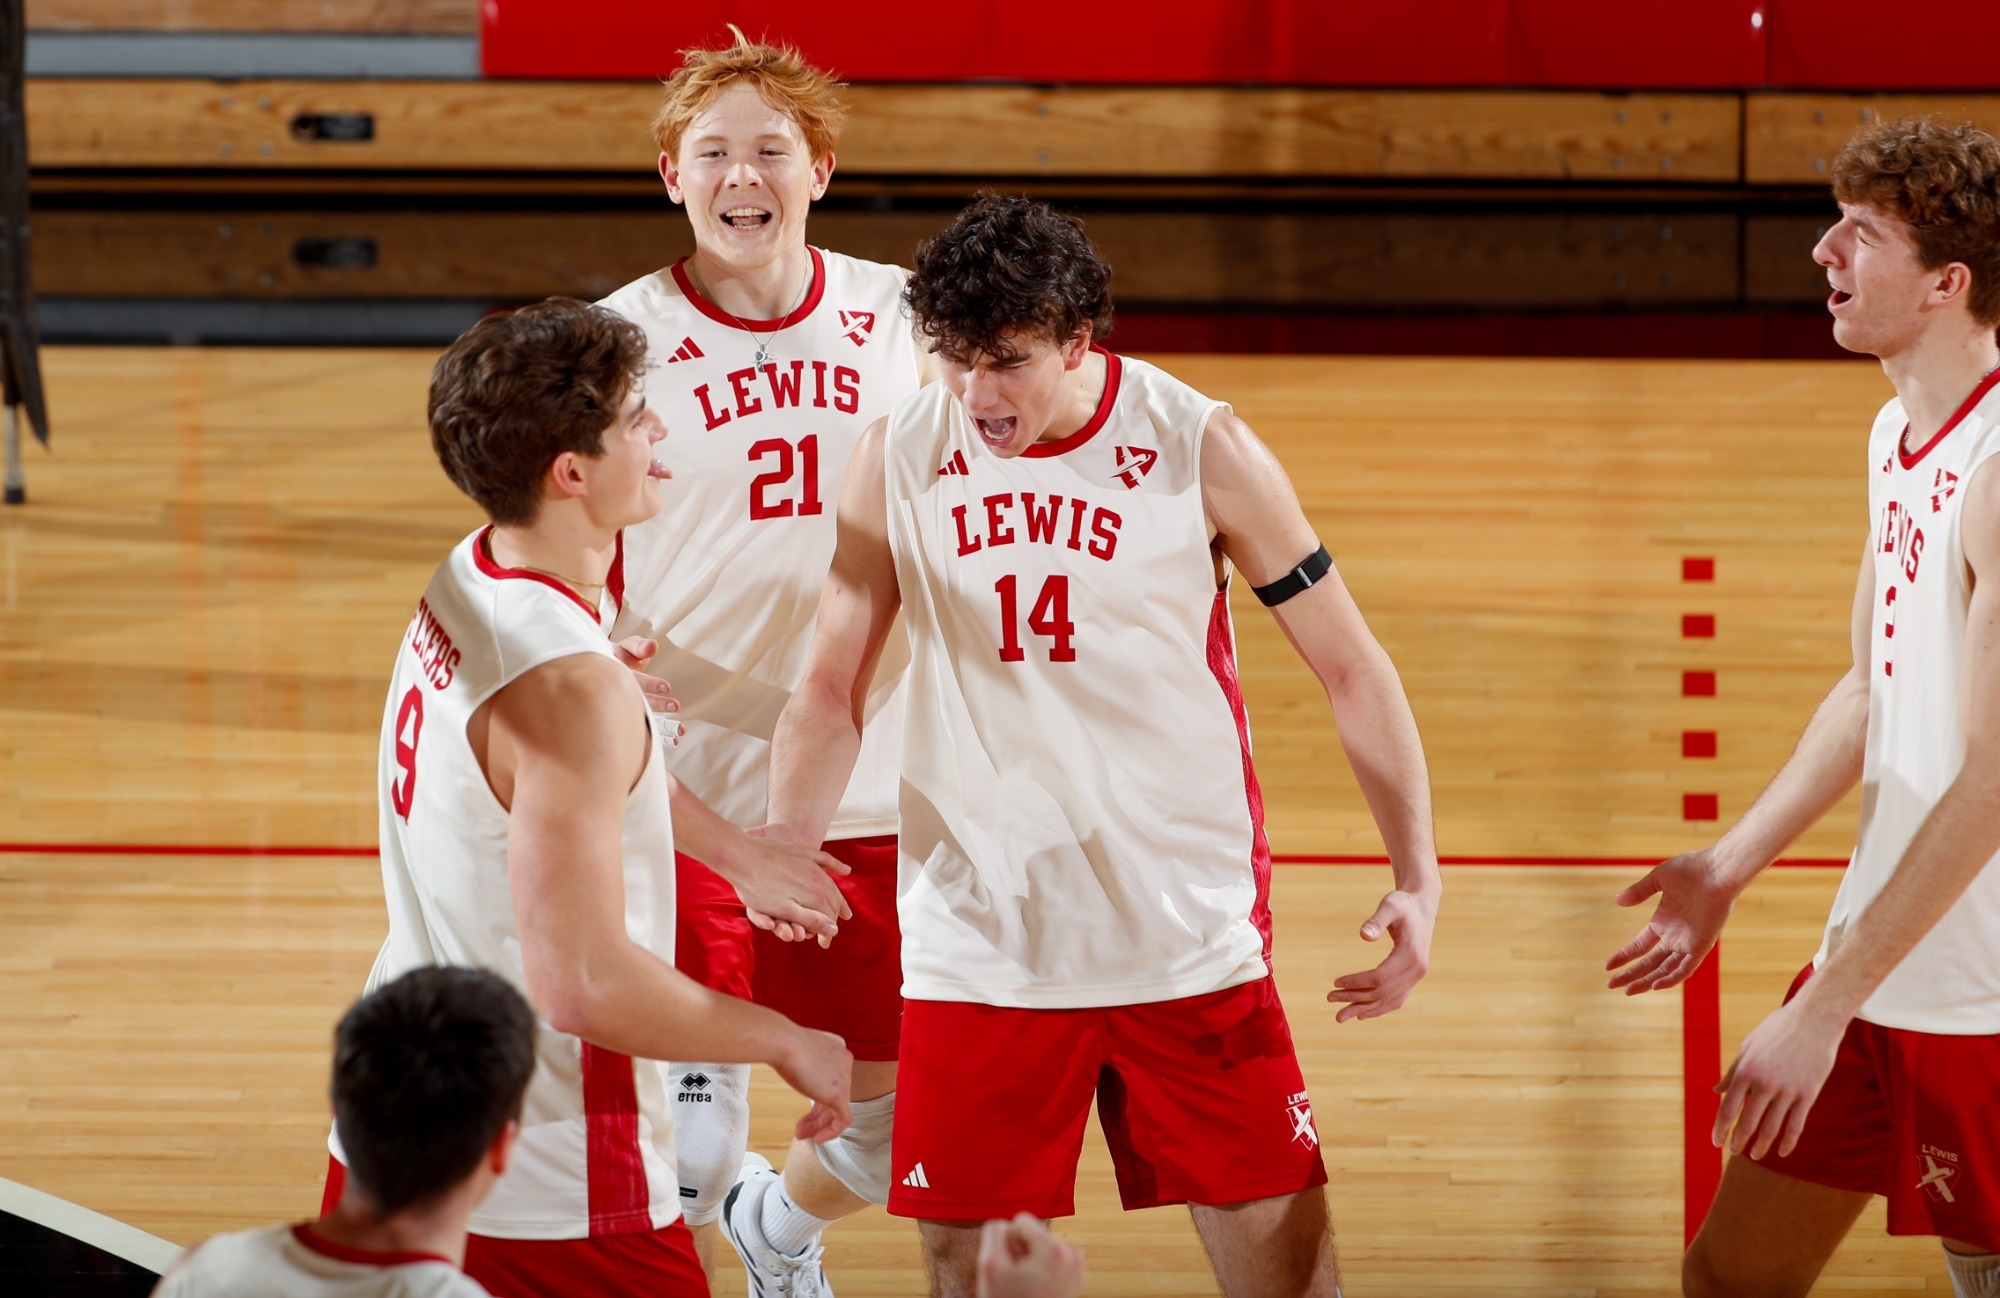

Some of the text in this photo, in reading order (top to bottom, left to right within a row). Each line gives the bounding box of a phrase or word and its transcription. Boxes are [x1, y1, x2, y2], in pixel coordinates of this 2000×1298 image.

[693, 360, 860, 432] LEWIS
[747, 434, 823, 521] 21
[951, 492, 1123, 562] LEWIS
[408, 596, 461, 691] LYERS
[994, 574, 1077, 662] 14
[391, 683, 424, 826] 9
[678, 1092, 712, 1103] errea
[1287, 1090, 1309, 1105] LEW
[1921, 1144, 1959, 1162] LEWIS
